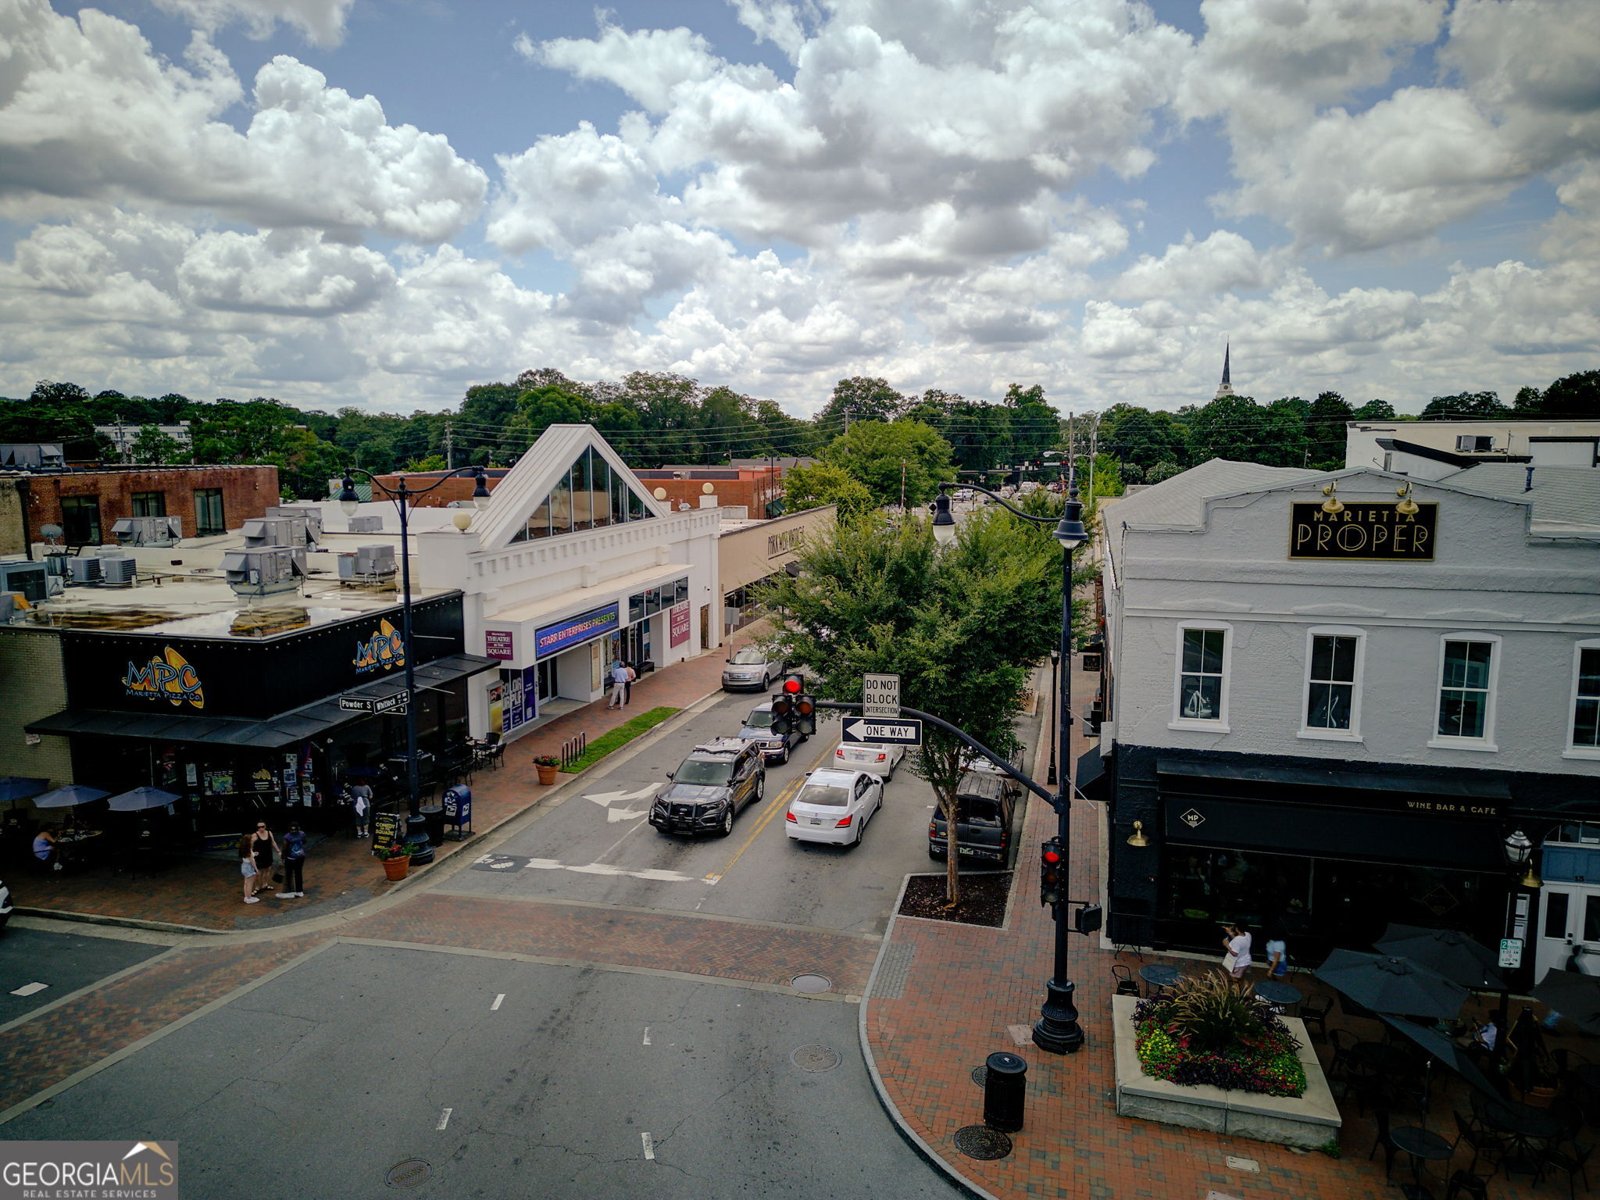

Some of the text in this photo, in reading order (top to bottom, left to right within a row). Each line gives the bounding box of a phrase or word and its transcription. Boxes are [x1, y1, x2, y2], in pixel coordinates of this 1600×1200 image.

[1313, 510, 1415, 522] MARIETTA
[1297, 523, 1428, 552] PROPER
[558, 620, 592, 641] ENTERPRISES
[356, 629, 405, 667] MPC
[487, 648, 512, 656] SQUARE
[127, 660, 202, 693] MPC
[866, 680, 897, 690] DO NOT
[341, 699, 364, 709] Powder
[866, 694, 897, 704] BLOCK
[865, 706, 897, 714] INTERSECTION
[866, 726, 909, 737] ONE WAY
[1407, 801, 1432, 809] WINE
[1436, 803, 1455, 811] BAR
[1502, 940, 1508, 948] 2
